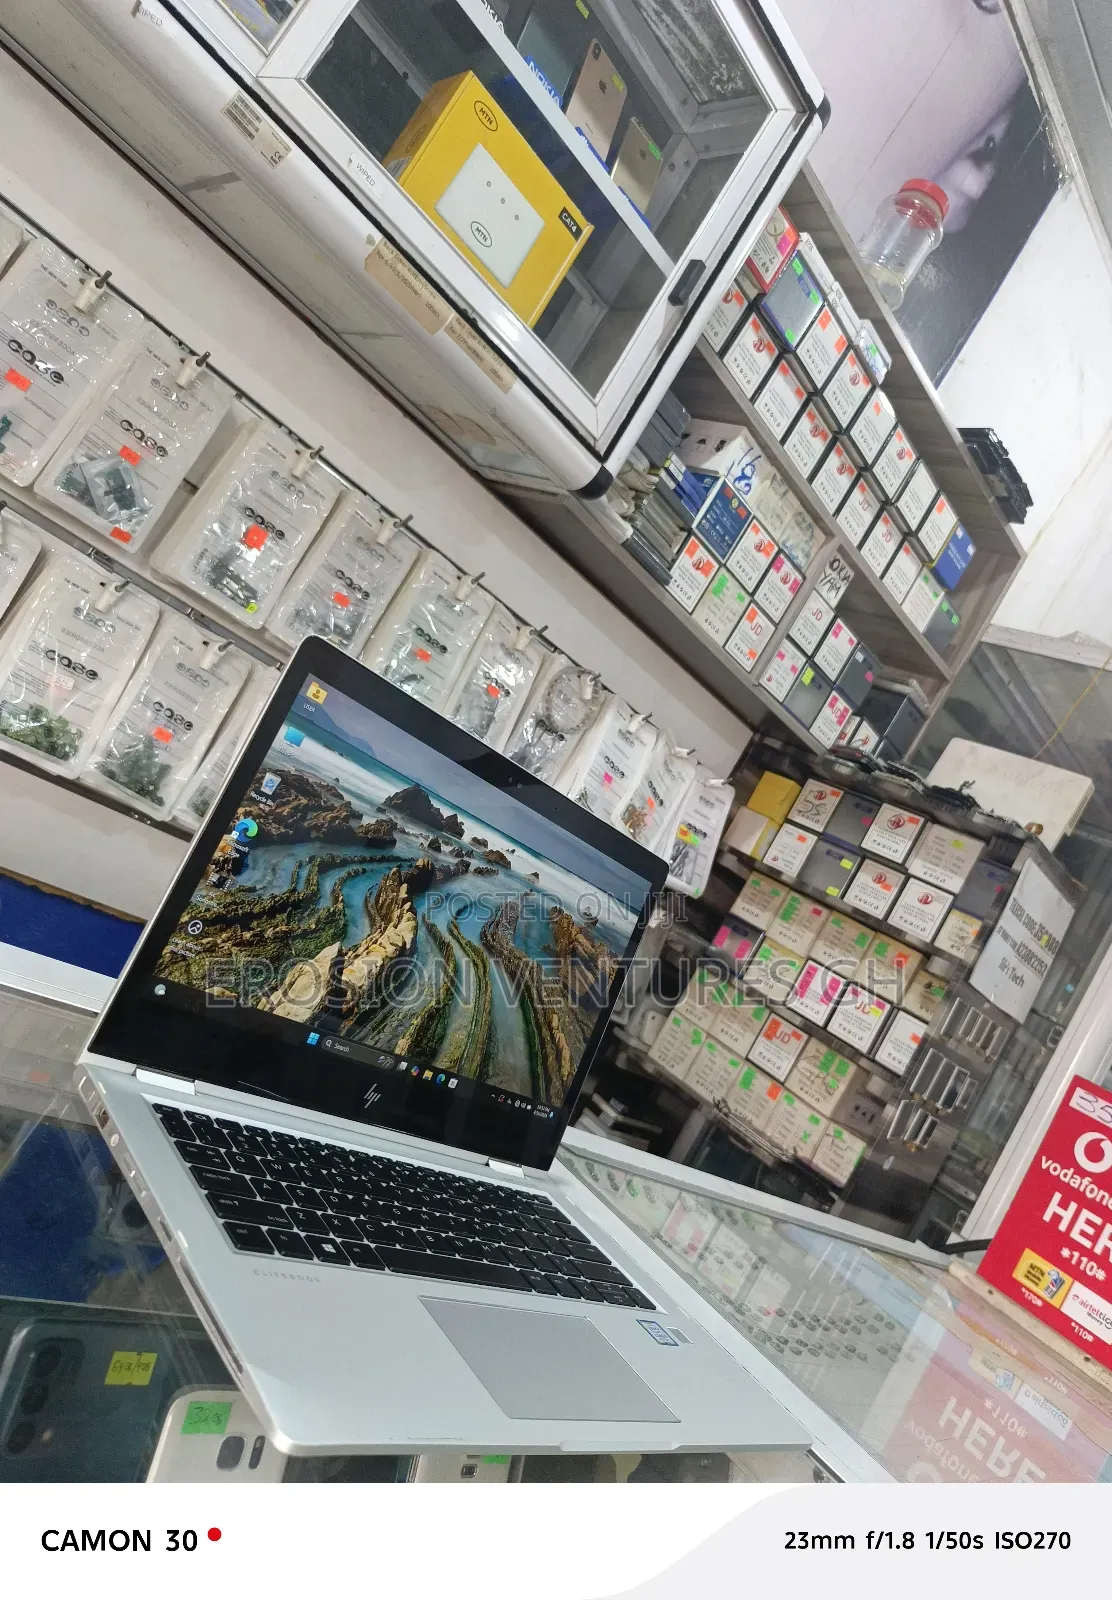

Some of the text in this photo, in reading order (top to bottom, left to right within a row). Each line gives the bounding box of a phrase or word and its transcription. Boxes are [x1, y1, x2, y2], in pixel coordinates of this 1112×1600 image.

[479, 106, 494, 126] MTN
[356, 162, 377, 188] WIPED
[561, 211, 578, 234] CAT4
[474, 226, 490, 243] MTN
[119, 419, 168, 458] case
[811, 608, 824, 622] JD
[750, 622, 764, 637] JD
[45, 649, 99, 681] case
[153, 701, 194, 731] case
[303, 702, 316, 713] USER
[603, 755, 626, 780] case
[228, 840, 250, 852] Microsoft
[1007, 965, 1027, 989] Tech
[774, 1027, 792, 1045] JD
[334, 1042, 350, 1053] Search
[1040, 1155, 1112, 1208] vodafone
[252, 1268, 323, 1284] ELITEBOOK
[1029, 1261, 1046, 1278] MTN
